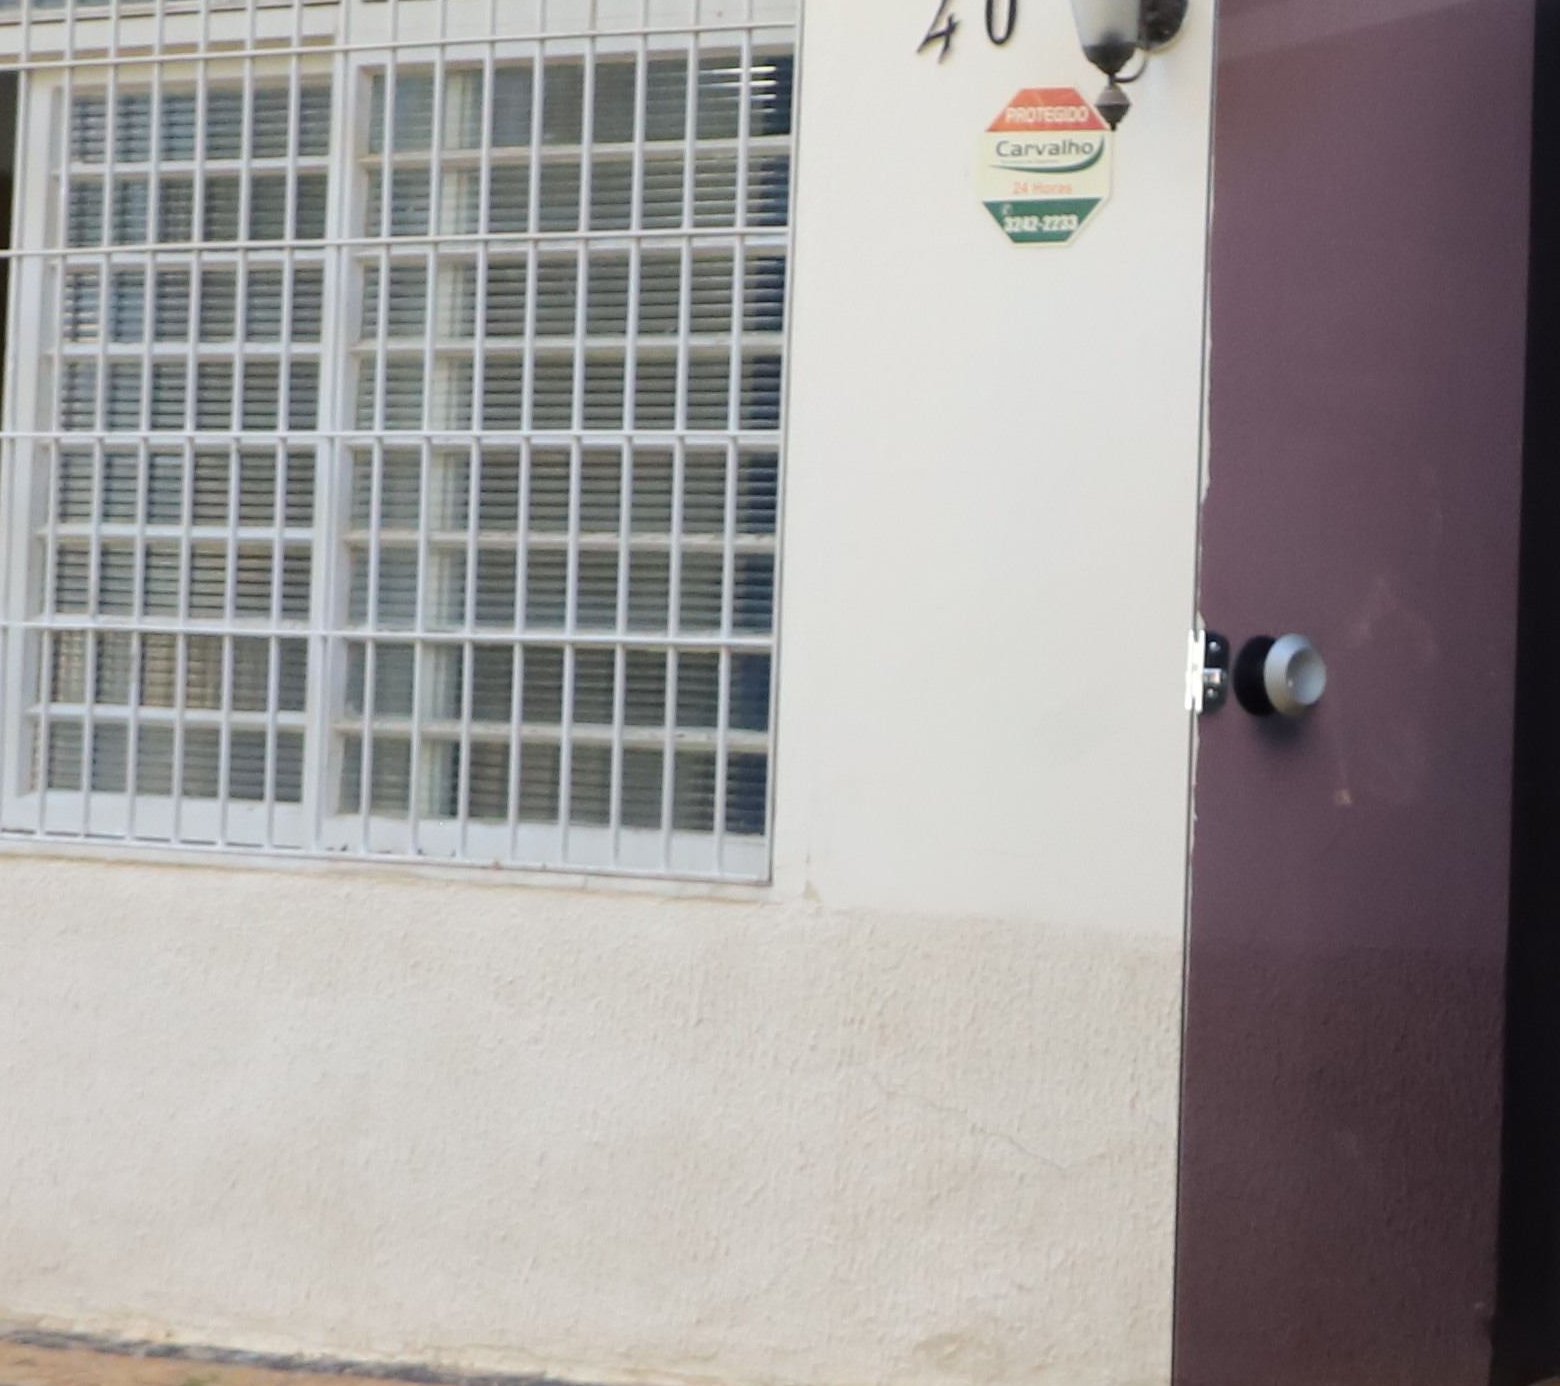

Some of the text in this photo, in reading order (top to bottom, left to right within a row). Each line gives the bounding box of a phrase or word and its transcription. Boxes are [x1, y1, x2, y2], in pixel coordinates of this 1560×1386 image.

[1005, 105, 1089, 123] PROTEGIDO
[996, 139, 1095, 158] Carvalho
[1012, 181, 1074, 195] 24 Horas
